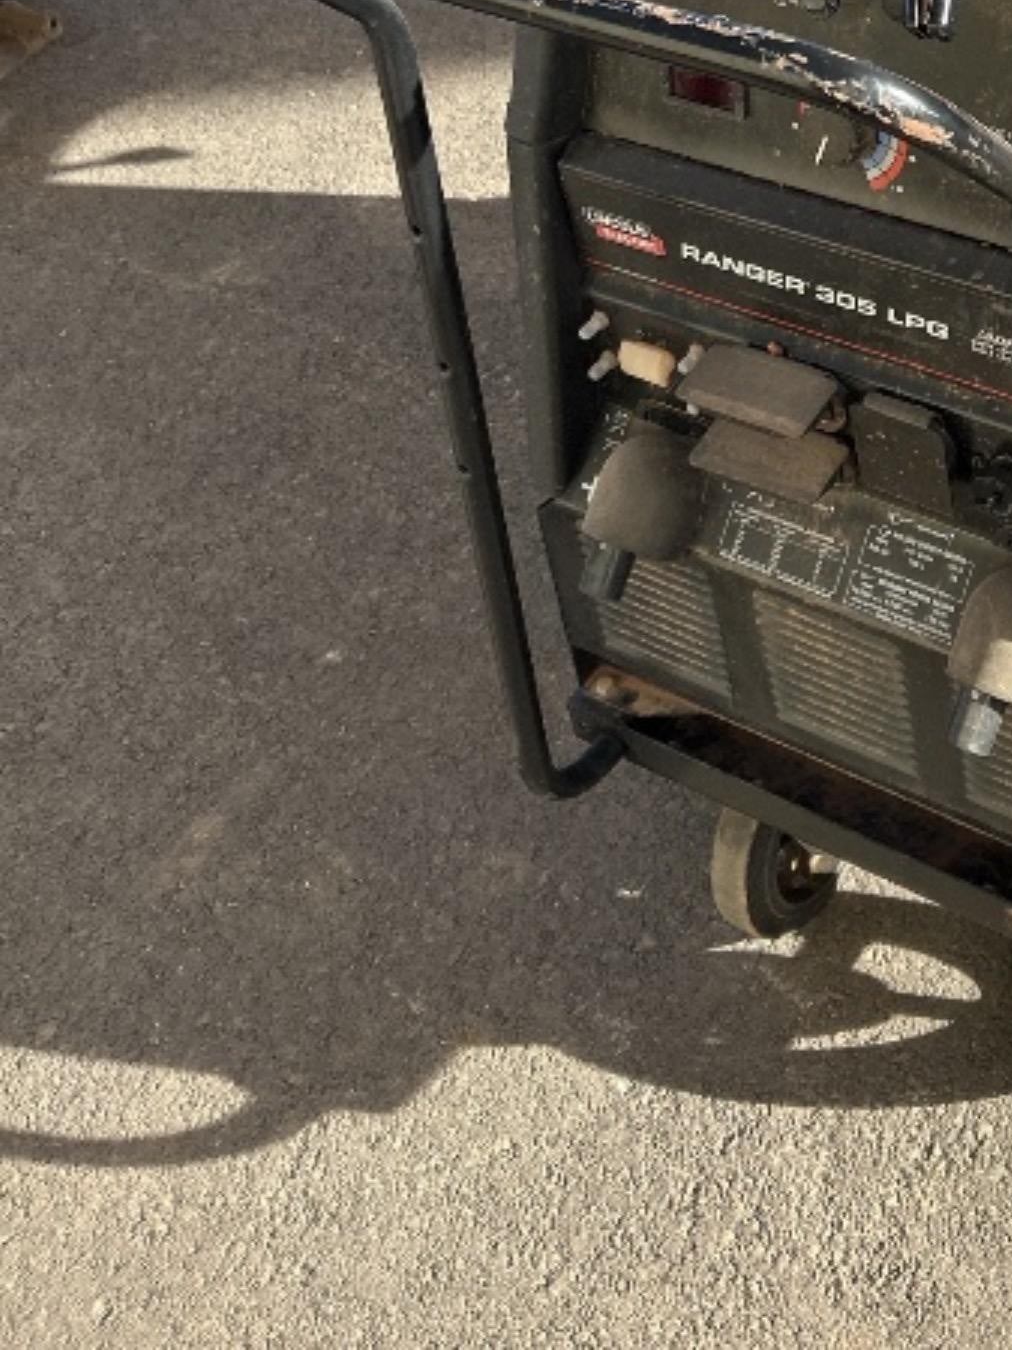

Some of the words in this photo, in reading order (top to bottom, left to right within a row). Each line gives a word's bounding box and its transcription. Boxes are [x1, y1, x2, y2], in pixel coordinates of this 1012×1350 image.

[680, 242, 806, 296] RANGER
[814, 283, 878, 318] 305
[886, 306, 951, 341] LPG
